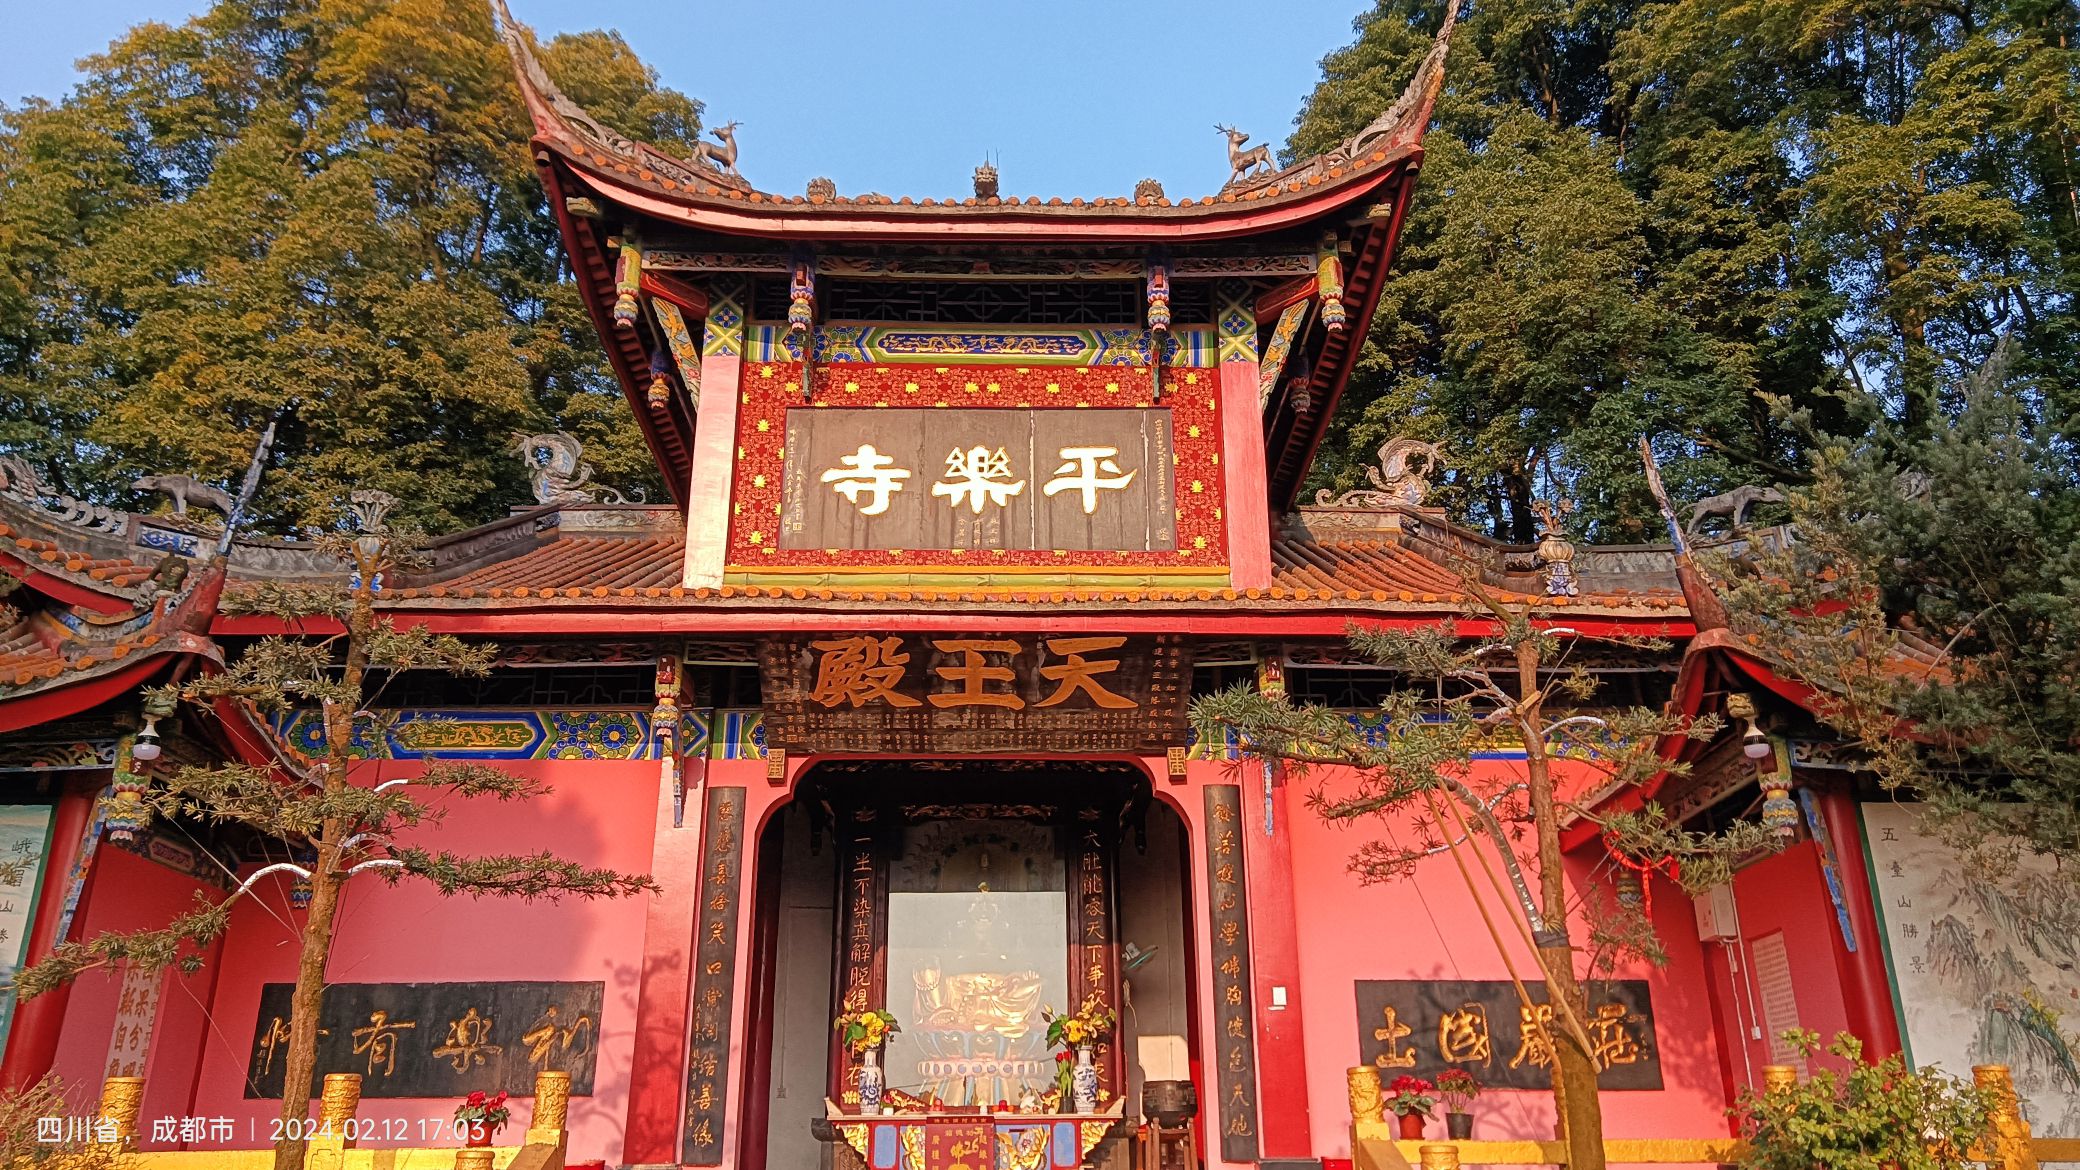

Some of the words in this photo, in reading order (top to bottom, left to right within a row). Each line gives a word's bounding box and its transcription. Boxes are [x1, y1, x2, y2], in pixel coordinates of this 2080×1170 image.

[820, 443, 1138, 515] 平樂寺
[808, 636, 1138, 711] 天王殿
